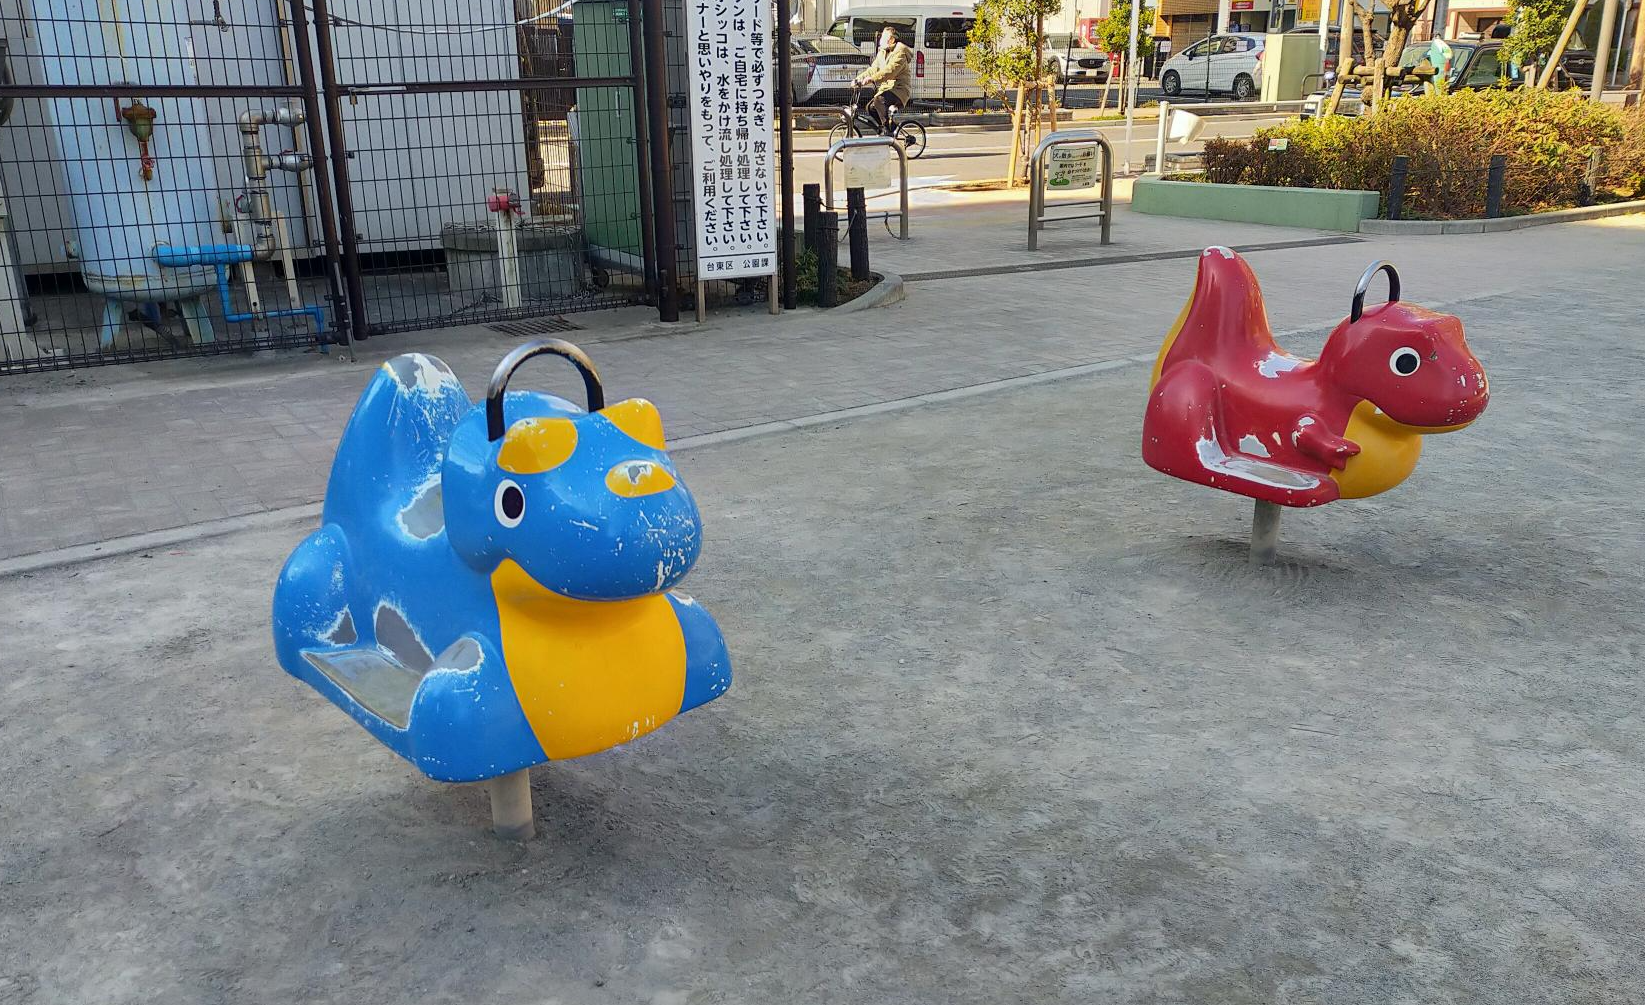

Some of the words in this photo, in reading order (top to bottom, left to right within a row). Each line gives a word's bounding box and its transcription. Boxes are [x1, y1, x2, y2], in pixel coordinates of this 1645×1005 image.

[696, 0, 718, 251] ナーと思いやりをもって、ご利用ください。
[715, 0, 735, 250] シッコは、水をかけ流し処理して下さい。
[751, 0, 768, 248] ード等で必ずつなぎ、放さないで下さい。
[707, 260, 734, 272] 台東区
[743, 258, 769, 269] 公園課
